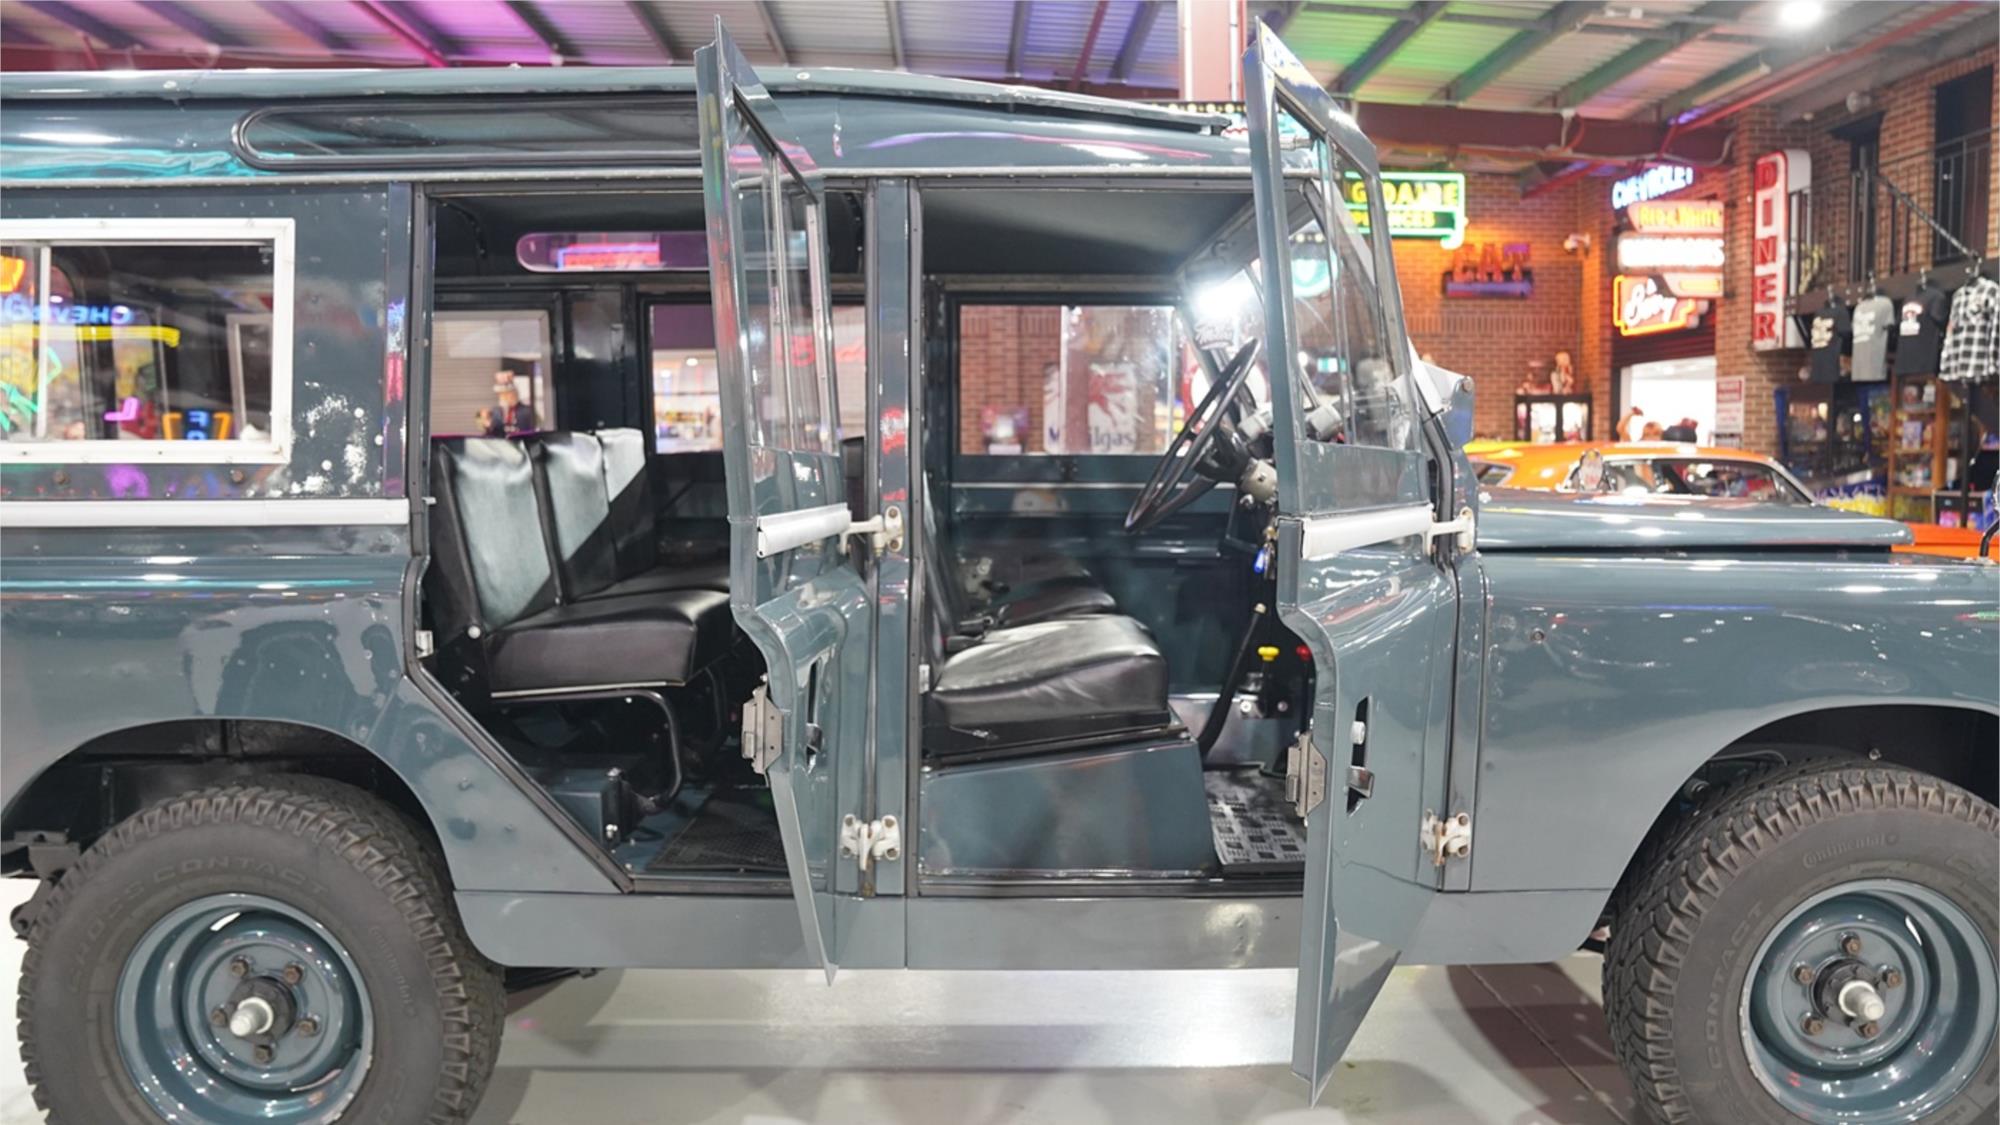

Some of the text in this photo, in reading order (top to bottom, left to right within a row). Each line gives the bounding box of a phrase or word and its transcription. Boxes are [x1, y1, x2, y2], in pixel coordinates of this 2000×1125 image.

[1453, 243, 1531, 283] EAT
[1754, 162, 1778, 340] DINER
[153, 854, 330, 896] CONTACT
[1705, 900, 1764, 1070] CONTACT
